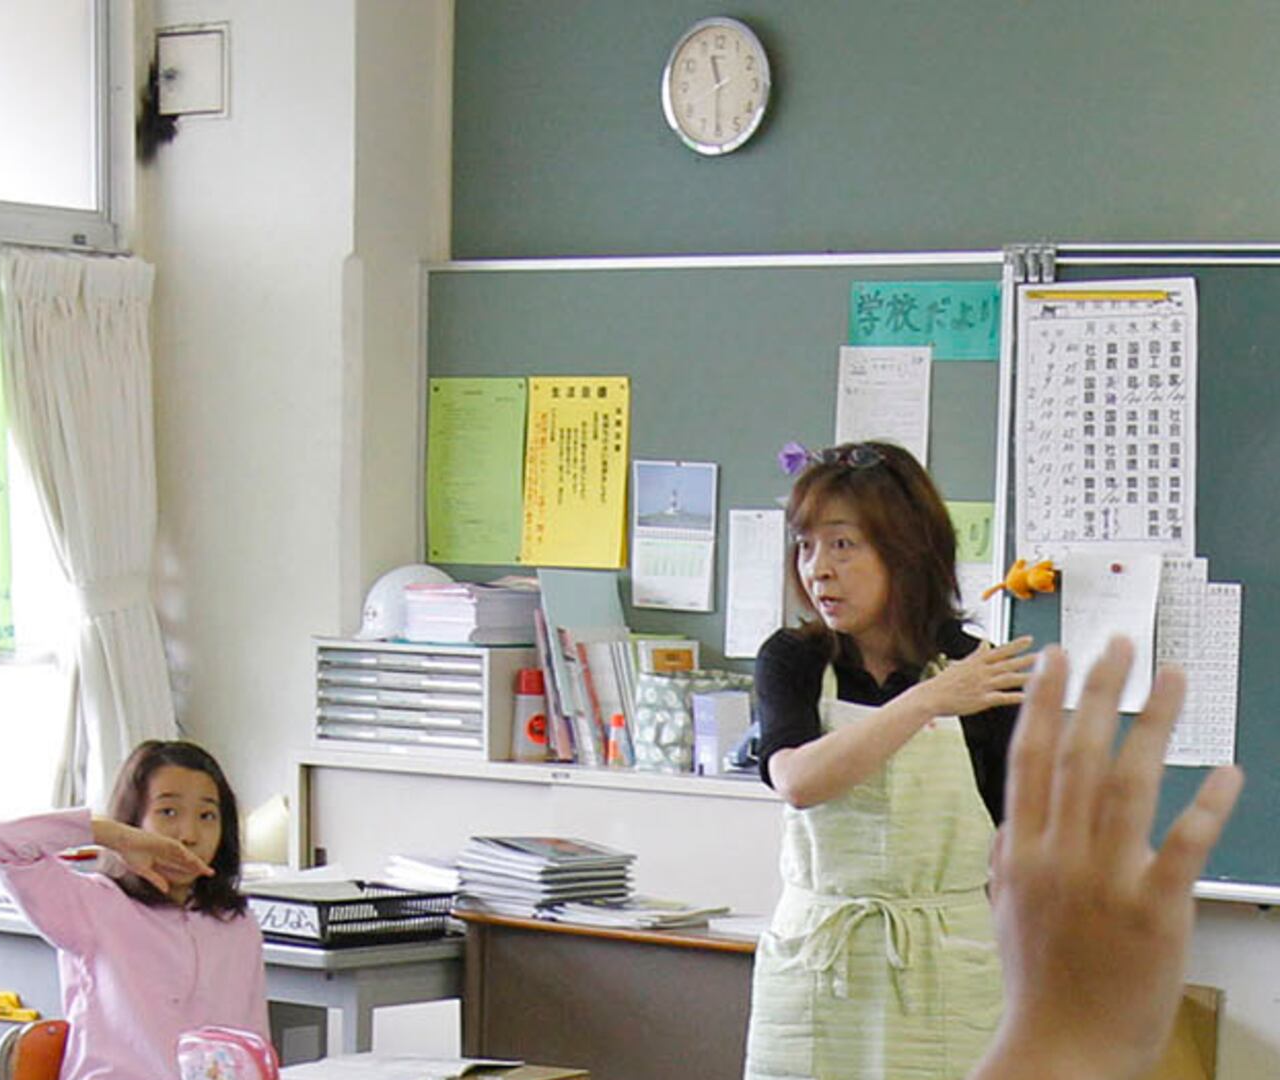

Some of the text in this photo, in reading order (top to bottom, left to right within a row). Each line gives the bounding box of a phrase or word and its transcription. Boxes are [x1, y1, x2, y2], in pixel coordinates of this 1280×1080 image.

[857, 289, 1000, 340] 学校だより
